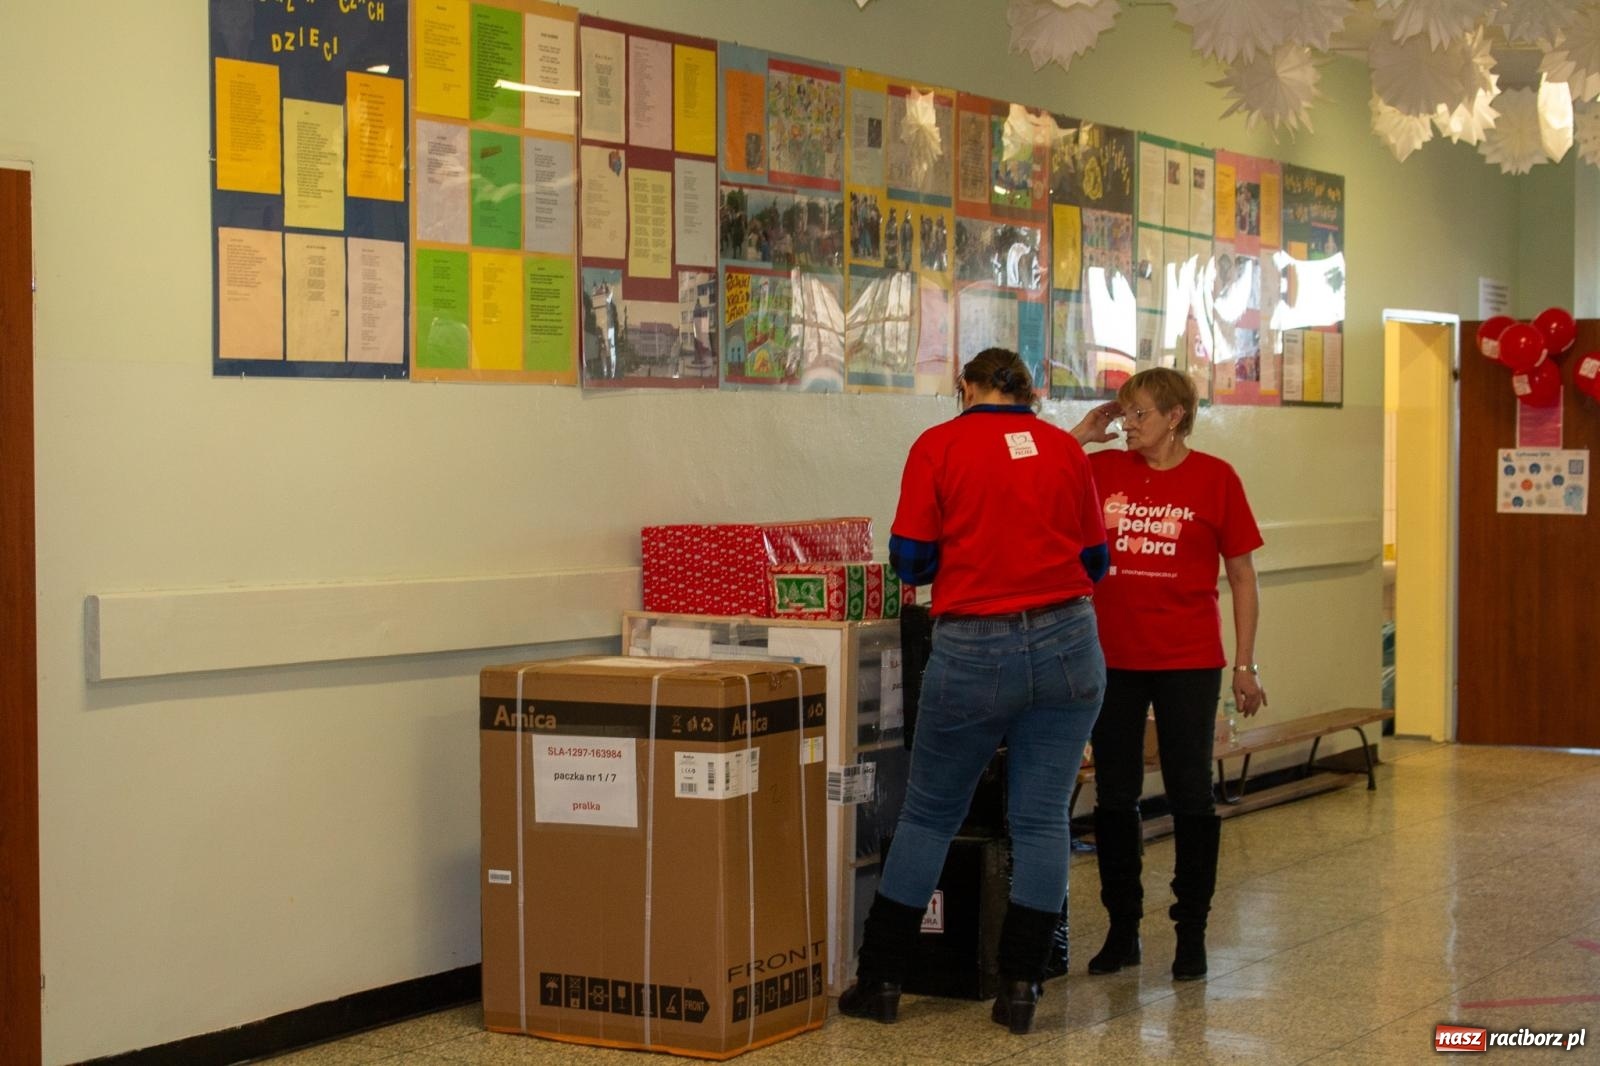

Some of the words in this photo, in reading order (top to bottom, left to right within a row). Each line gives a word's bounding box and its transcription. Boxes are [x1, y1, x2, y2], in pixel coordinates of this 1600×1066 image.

[271, 26, 339, 62] DZIECI
[1117, 516, 1176, 536] pełen
[493, 704, 557, 729] Amica
[732, 709, 768, 737] Amica
[547, 746, 622, 759] SLA-1297-163984
[553, 771, 585, 783] paczka
[586, 773, 596, 782] nr
[597, 773, 603, 782] 1
[604, 773, 610, 782] /
[611, 773, 617, 783] 7
[572, 800, 601, 812] pralka
[727, 938, 826, 983] FRONT
[684, 1000, 705, 1012] FRONT
